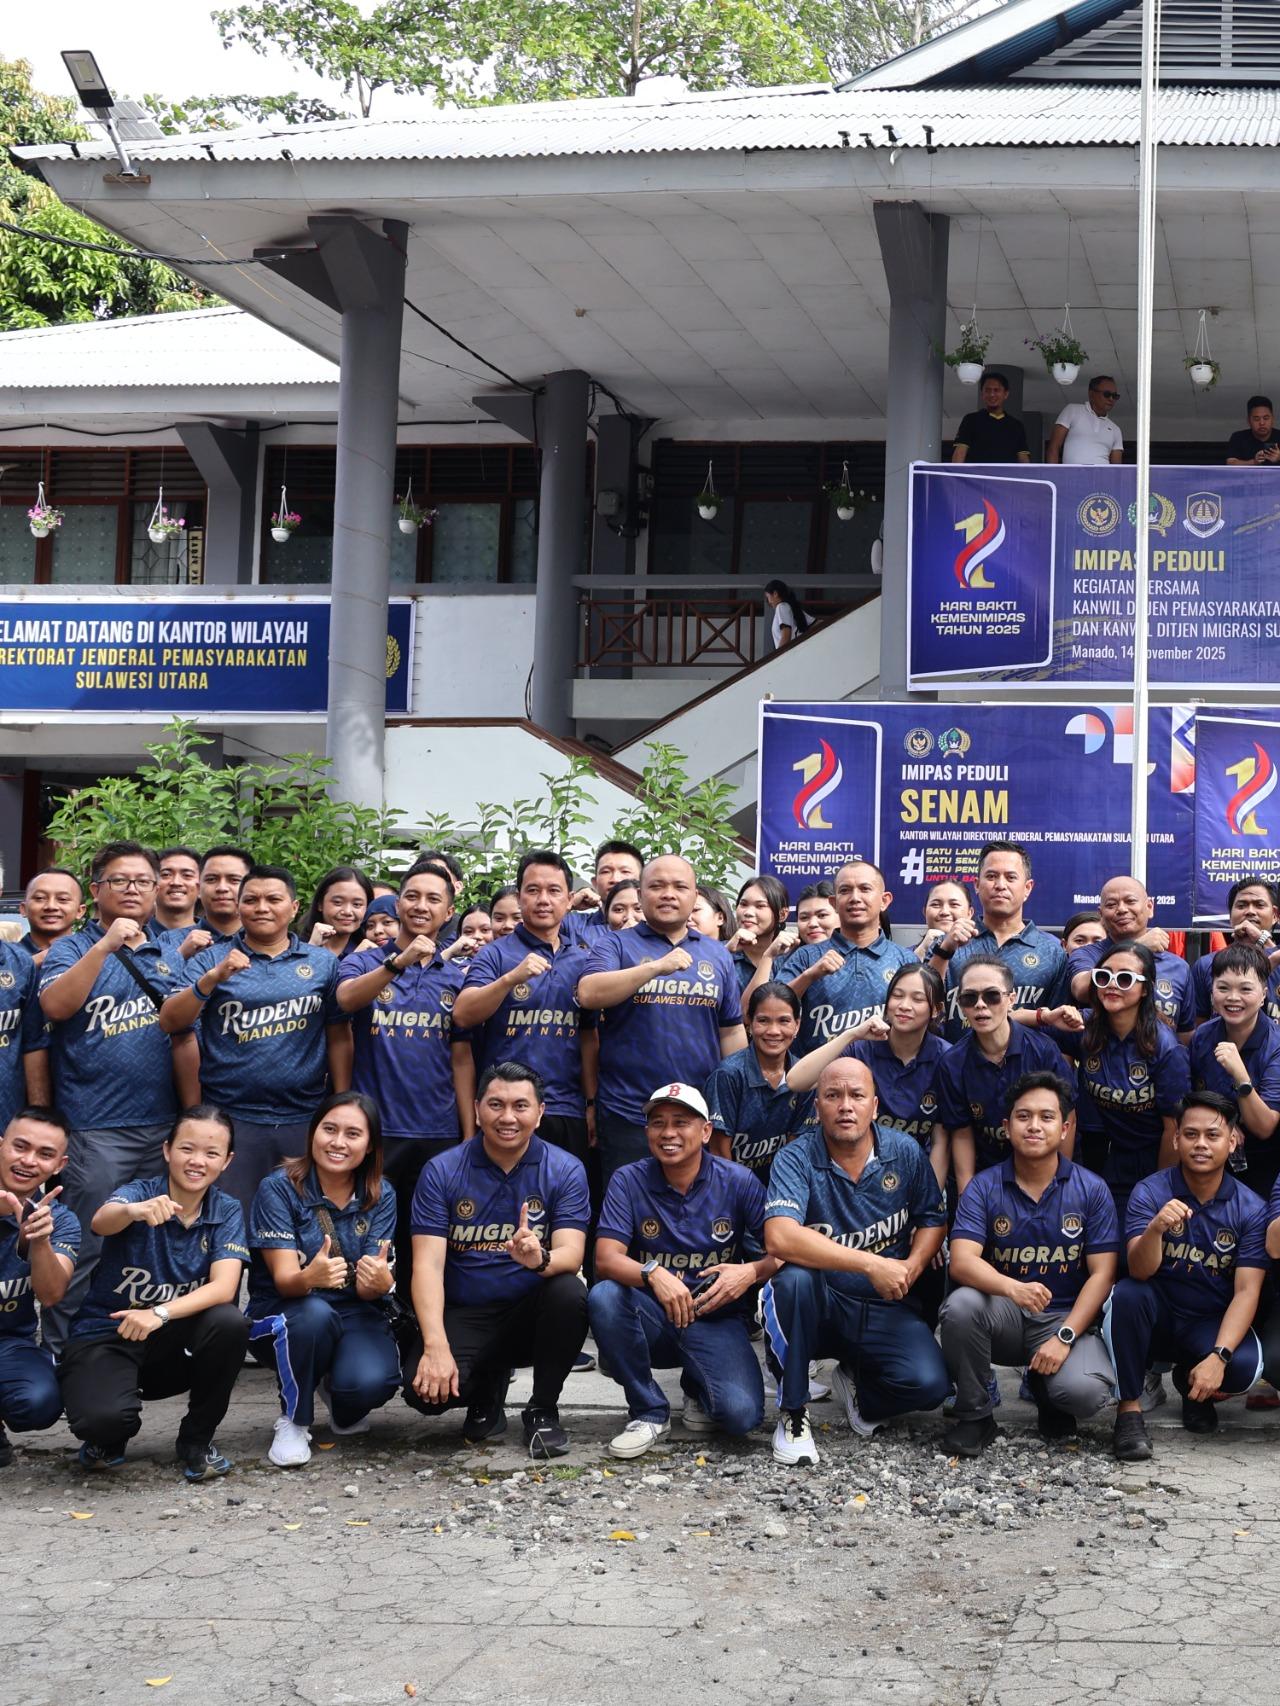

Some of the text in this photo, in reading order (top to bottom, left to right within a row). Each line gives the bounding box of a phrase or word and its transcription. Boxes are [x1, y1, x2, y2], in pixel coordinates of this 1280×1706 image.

[1074, 549, 1225, 571] IMIPA PEDULI
[1073, 579, 1200, 595] KEGIATAN ERSAMA
[940, 601, 1017, 611] HARI BAKTI
[1073, 600, 1122, 615] KANWIL
[1126, 600, 1167, 616] DJEN
[931, 613, 1026, 623] KEMENIMIPAS
[65, 620, 133, 643] DATANG
[137, 621, 155, 643] DI
[158, 621, 226, 644] KANTOR
[231, 621, 308, 644] WILAYAH
[936, 625, 1020, 635] TAHUN 2025
[1072, 621, 1098, 636] DAN
[1103, 621, 1152, 637] KANWL
[1157, 622, 1198, 638] DITJEN
[1203, 622, 1261, 638] IMIGRASI
[80, 648, 157, 666] JENDERAL
[162, 649, 307, 667] PEMASYARAKATAN
[1072, 644, 1226, 660] Manado, 14 ovember 2025
[76, 671, 209, 690] SULAWESI UTARA
[901, 764, 1009, 781] IMIPAS PEDULI
[900, 789, 1008, 824] SENAM
[900, 830, 1174, 843] KANTOR WILAYAH DIREKTORAT JENDERAL PEMASYARAKATAN SULAI UTARA
[779, 841, 854, 851] HARI BAKTI
[1211, 848, 1244, 858] HARI
[770, 853, 862, 863] KEMENIMIPAS
[775, 865, 839, 875] TAHUN 20
[1157, 896, 1175, 905] 2025
[638, 979, 719, 998] MIGRASI
[633, 995, 685, 1005] SULAWESI
[372, 1009, 450, 1029] IMIGRAS
[508, 1009, 579, 1027] IMIGRA
[238, 1018, 307, 1044] MANADO
[506, 1027, 577, 1038] MANAD
[1089, 1081, 1155, 1105] IGRASI
[994, 1242, 1083, 1263] MIGRASI
[1003, 1263, 1080, 1274] AHUN
[113, 1267, 209, 1303] RUDEN
